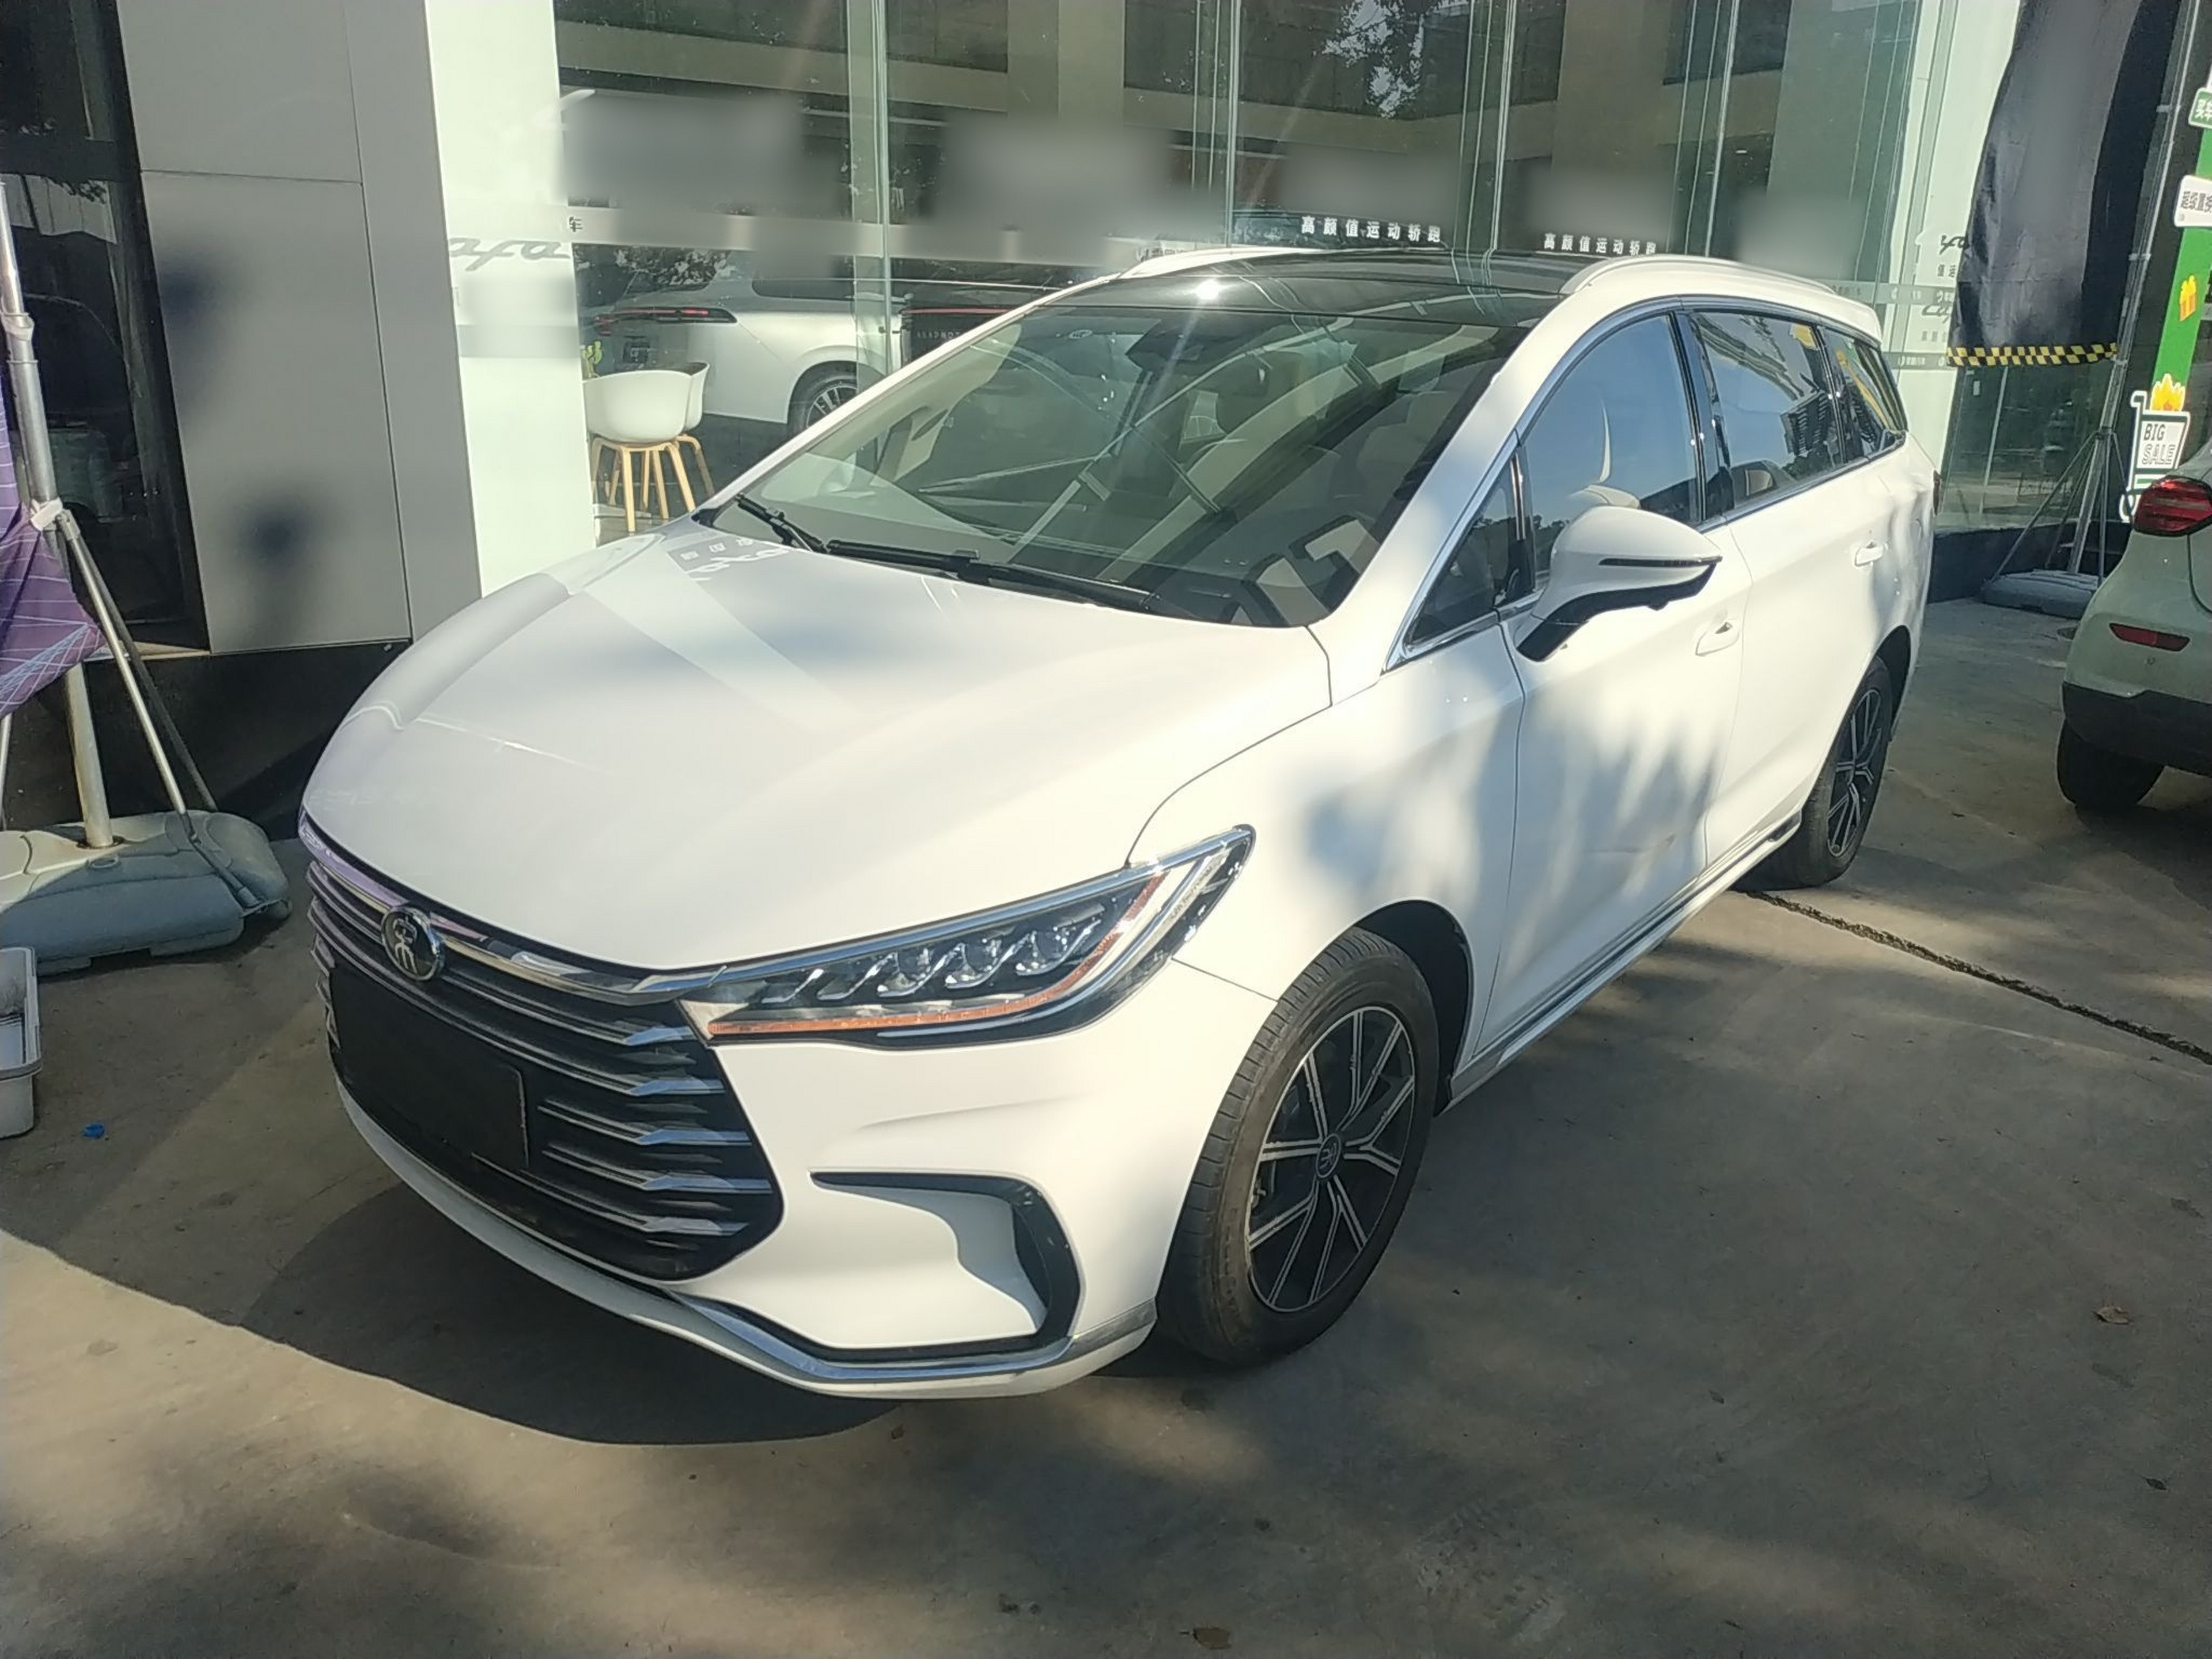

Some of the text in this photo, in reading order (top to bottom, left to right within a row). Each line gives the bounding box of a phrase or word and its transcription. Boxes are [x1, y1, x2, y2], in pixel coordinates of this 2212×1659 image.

[1302, 215, 1440, 243] 高颜值运动轿跑
[2143, 423, 2165, 441] BIG
[2142, 444, 2176, 465] SALE
